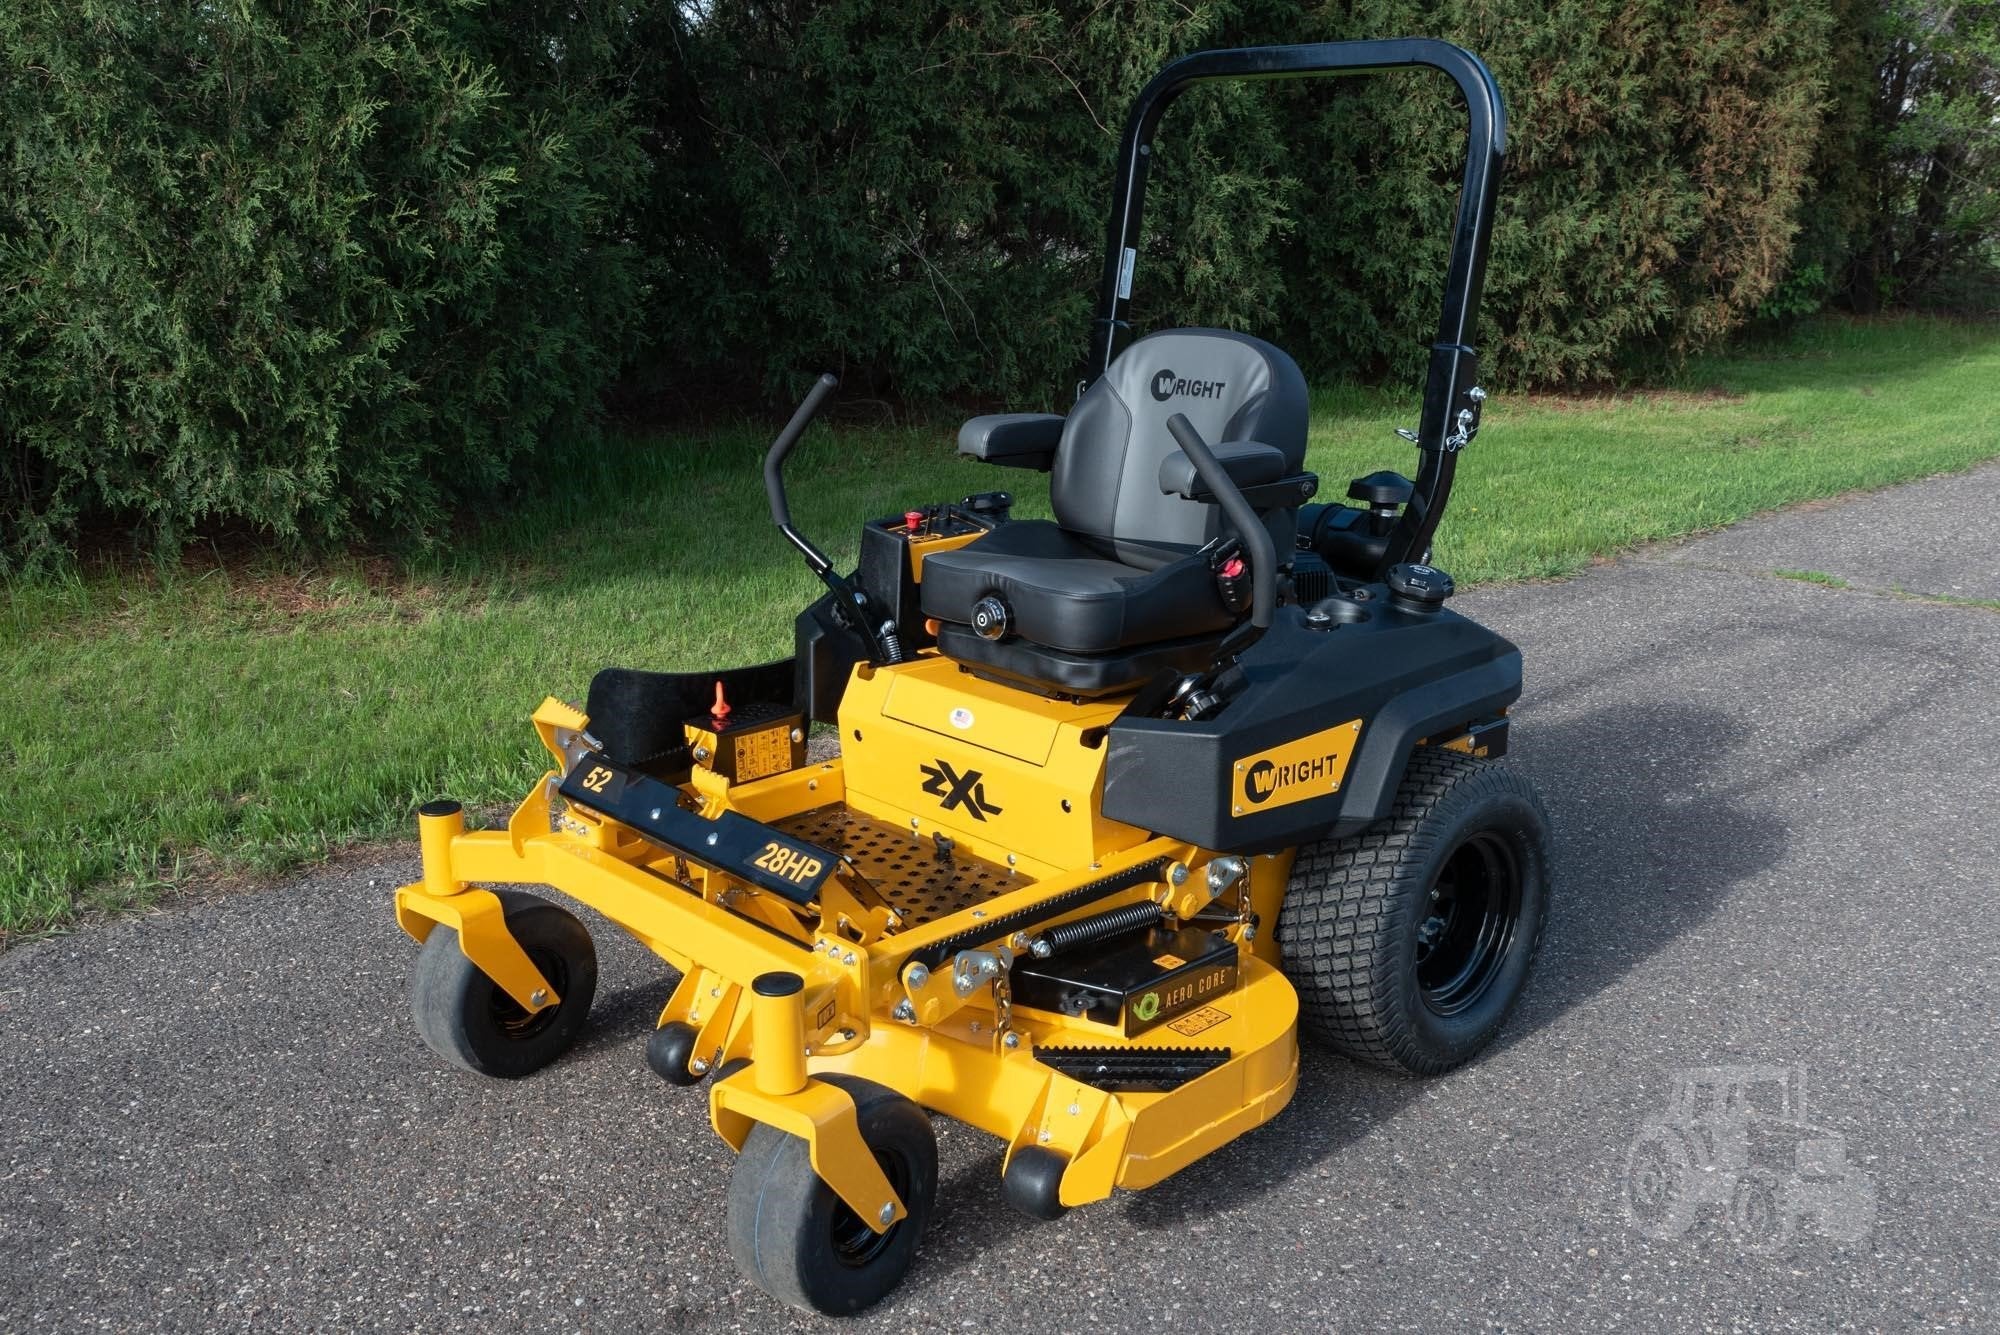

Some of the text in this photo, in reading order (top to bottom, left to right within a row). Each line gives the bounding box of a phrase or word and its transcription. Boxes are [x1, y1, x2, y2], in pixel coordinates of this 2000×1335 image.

[1151, 369, 1226, 402] WRIGHT
[582, 766, 613, 793] 52
[1245, 753, 1338, 804] WRIGHT
[753, 842, 822, 883] 28HP
[1165, 969, 1226, 1009] AERO CORE
